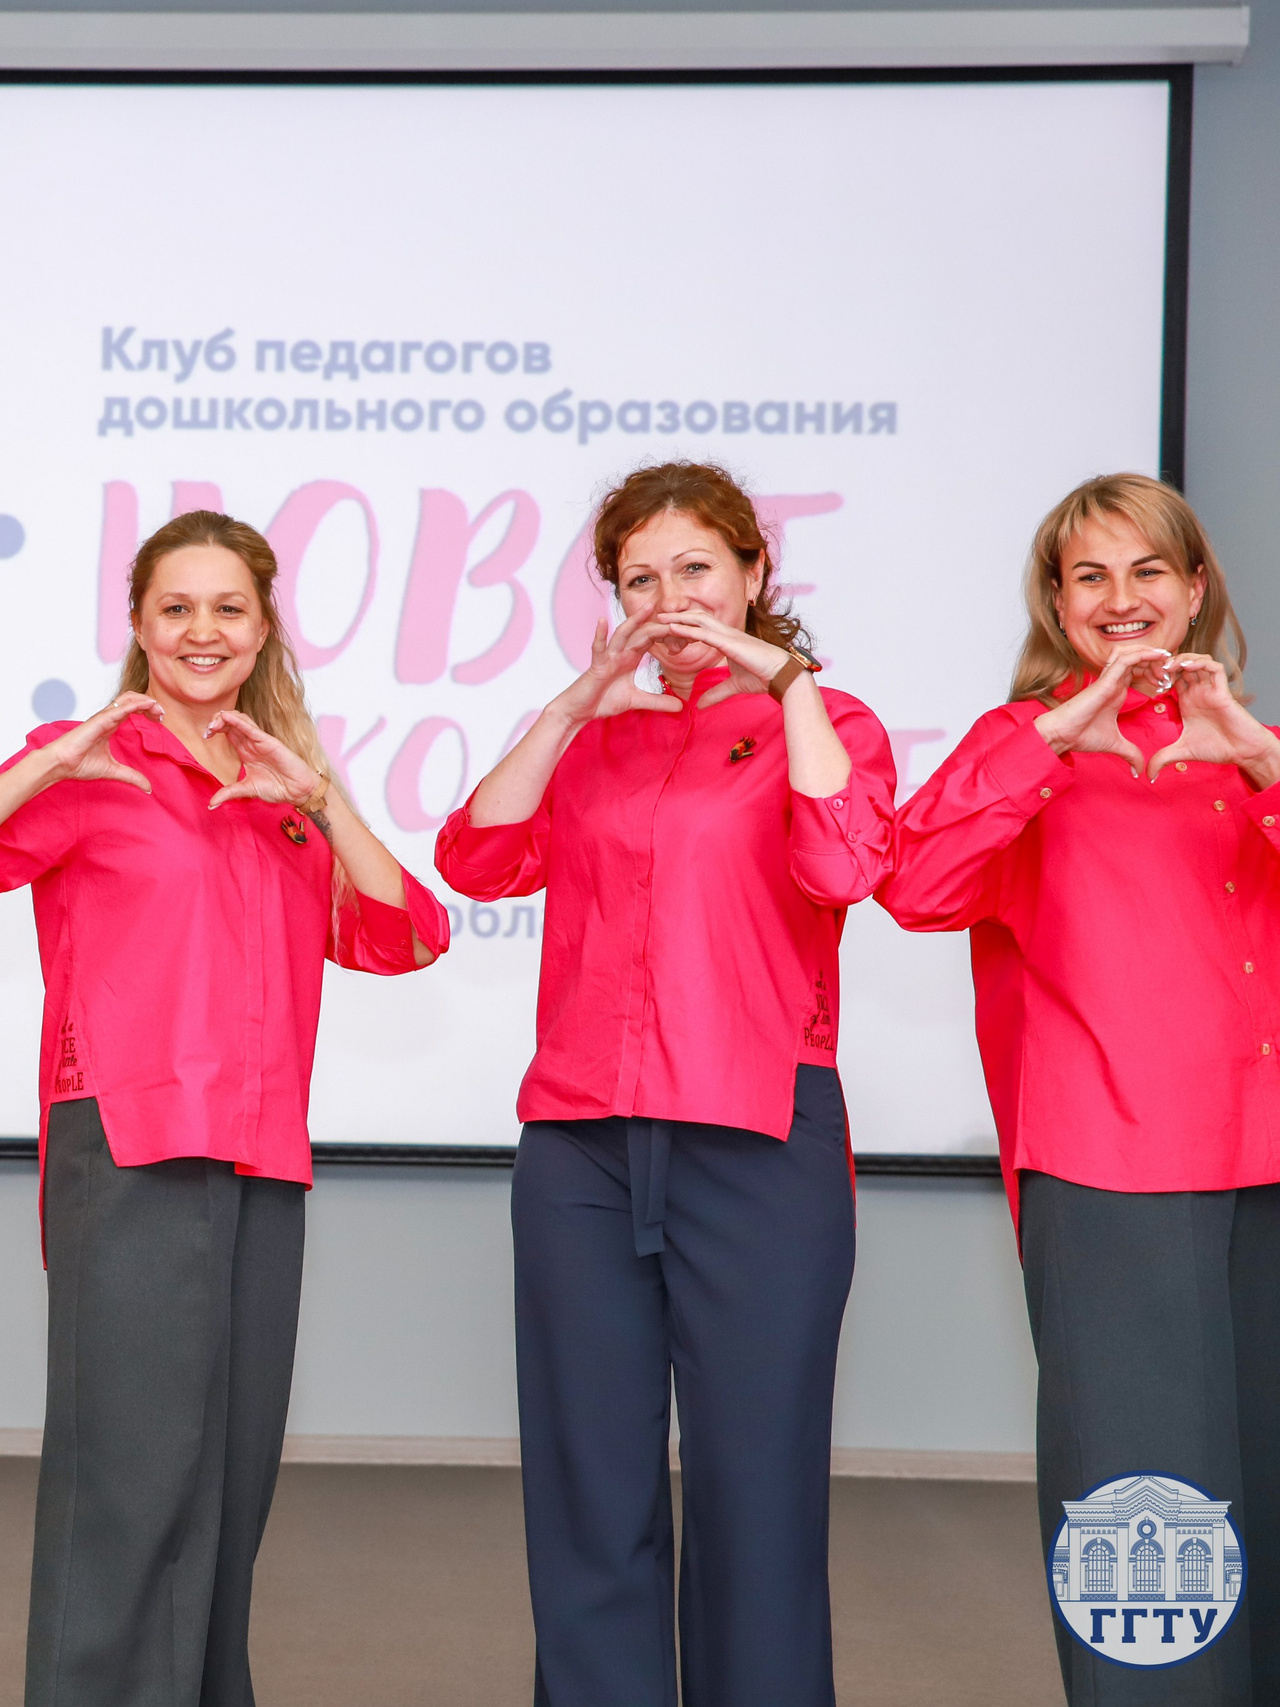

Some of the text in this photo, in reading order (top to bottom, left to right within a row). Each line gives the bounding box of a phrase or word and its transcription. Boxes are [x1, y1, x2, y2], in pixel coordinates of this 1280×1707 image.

[101, 326, 552, 383] Клуб педагогов
[98, 387, 898, 446] дошкольного образования
